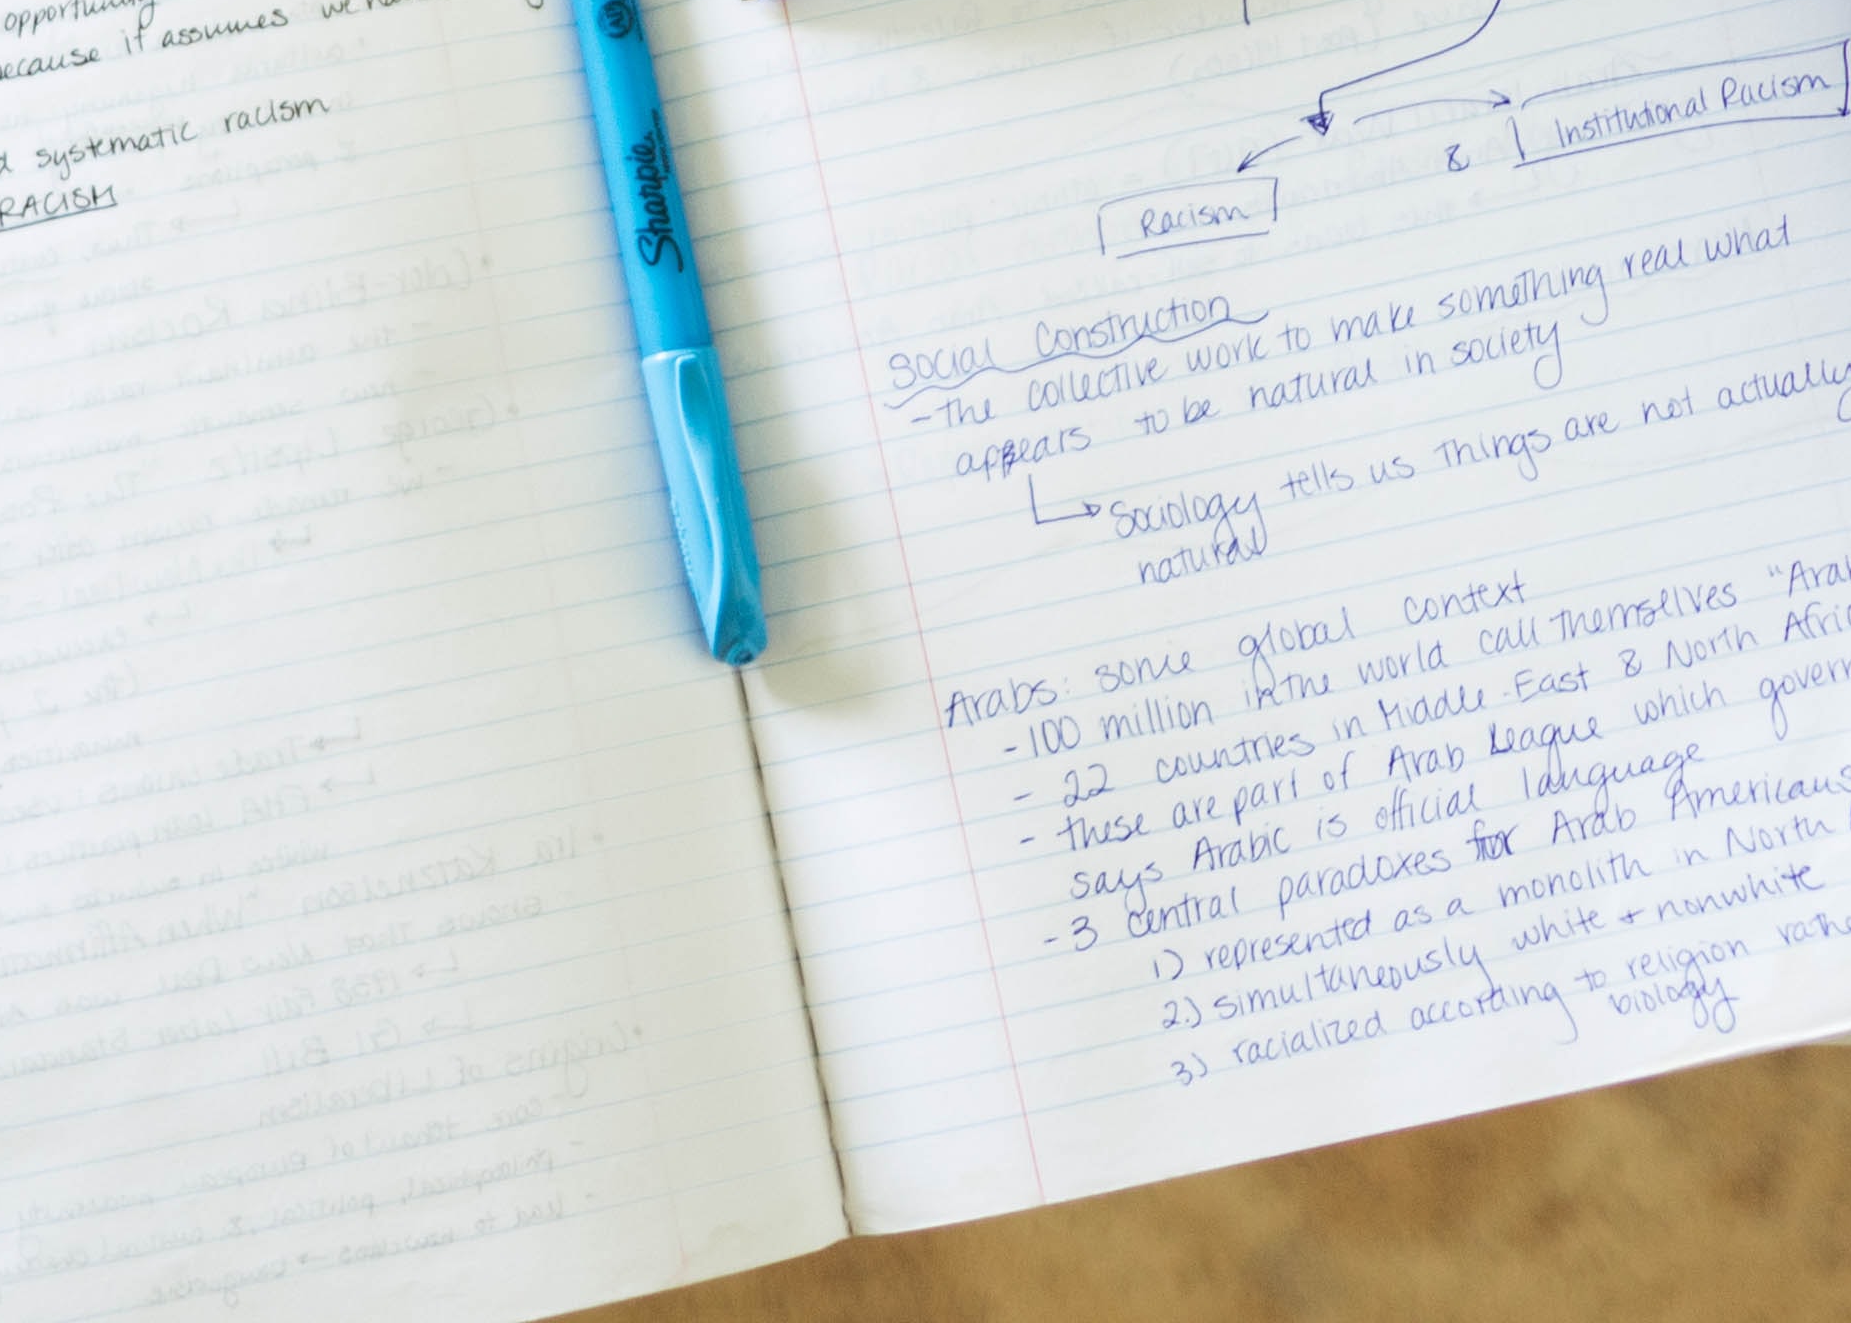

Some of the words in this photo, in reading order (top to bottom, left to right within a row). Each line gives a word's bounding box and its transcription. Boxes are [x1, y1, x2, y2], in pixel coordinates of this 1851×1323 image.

[1556, 87, 1709, 149] Institutional
[625, 129, 685, 274] Sharpie
[1028, 360, 1169, 411] collective
[1187, 333, 1266, 371] work
[1278, 328, 1313, 352] to
[1333, 300, 1429, 341] make
[1438, 264, 1611, 326] something
[1625, 238, 1688, 281] real
[1705, 214, 1790, 263] what
[1135, 410, 1170, 436] to
[1182, 394, 1222, 424] be
[1250, 358, 1378, 410] natural
[1406, 350, 1436, 377] in
[1451, 320, 1563, 390] society
[1280, 467, 1354, 497] tells
[1369, 457, 1416, 484] us
[1565, 414, 1619, 441] are
[1643, 394, 1695, 423] not
[1063, 763, 1116, 807] 22
[1155, 731, 1316, 784] countries
[1332, 715, 1364, 740] in
[1515, 666, 1590, 703] East
[1666, 628, 1759, 670] North
[1095, 650, 1193, 693] some
